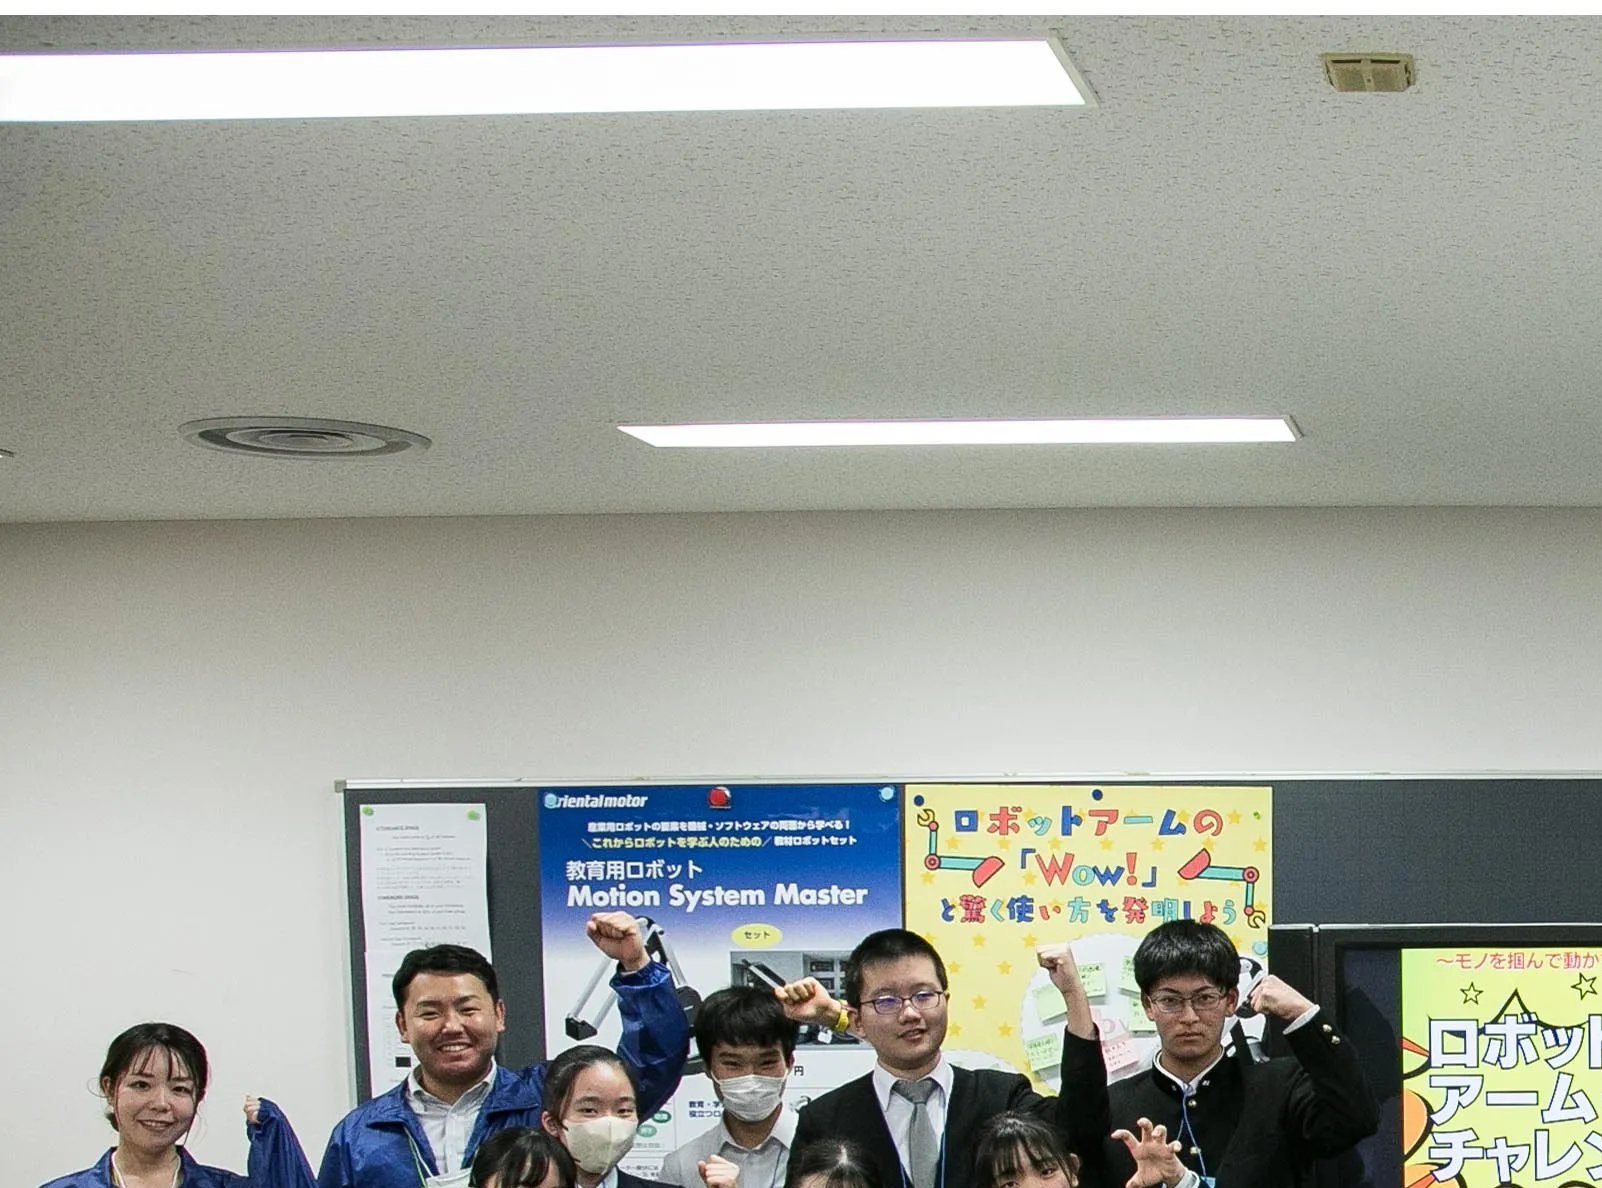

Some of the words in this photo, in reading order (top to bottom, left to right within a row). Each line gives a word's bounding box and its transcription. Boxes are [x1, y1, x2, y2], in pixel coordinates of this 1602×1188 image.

[545, 793, 648, 809] rientalmotor
[954, 805, 1224, 837] ロボットアームの
[591, 837, 763, 849] これからロボットを学ぶ人のための
[566, 860, 703, 881] 教育用ロボット
[567, 885, 661, 907] Motion
[669, 884, 766, 912] System
[774, 883, 868, 906] Master
[940, 894, 1238, 925] と驚く使い方を発明しよう
[743, 930, 771, 940] セット
[794, 1066, 804, 1077] 円
